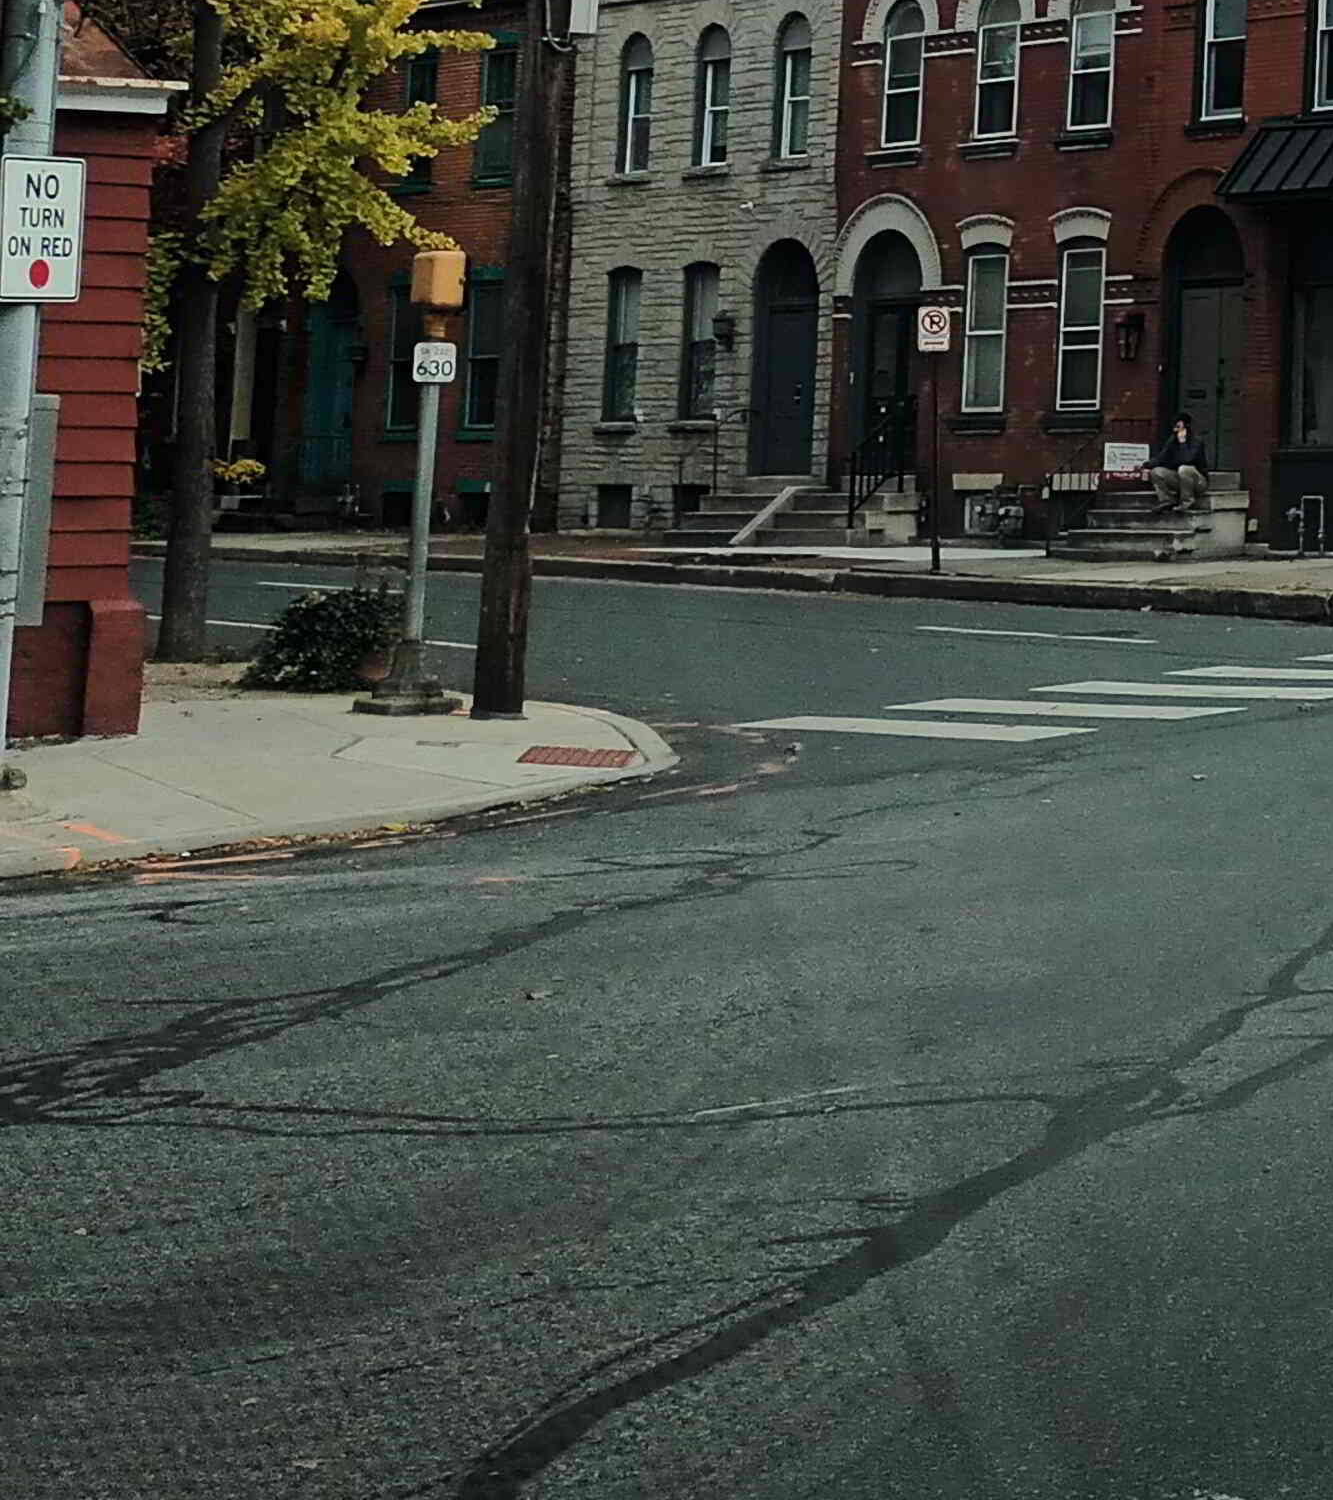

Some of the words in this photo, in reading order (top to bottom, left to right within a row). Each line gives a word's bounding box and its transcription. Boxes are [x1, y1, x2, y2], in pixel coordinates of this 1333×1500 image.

[26, 173, 60, 199] NO
[19, 207, 65, 228] TURN
[8, 235, 31, 257] ON
[40, 237, 73, 257] RED
[416, 360, 453, 376] 630
